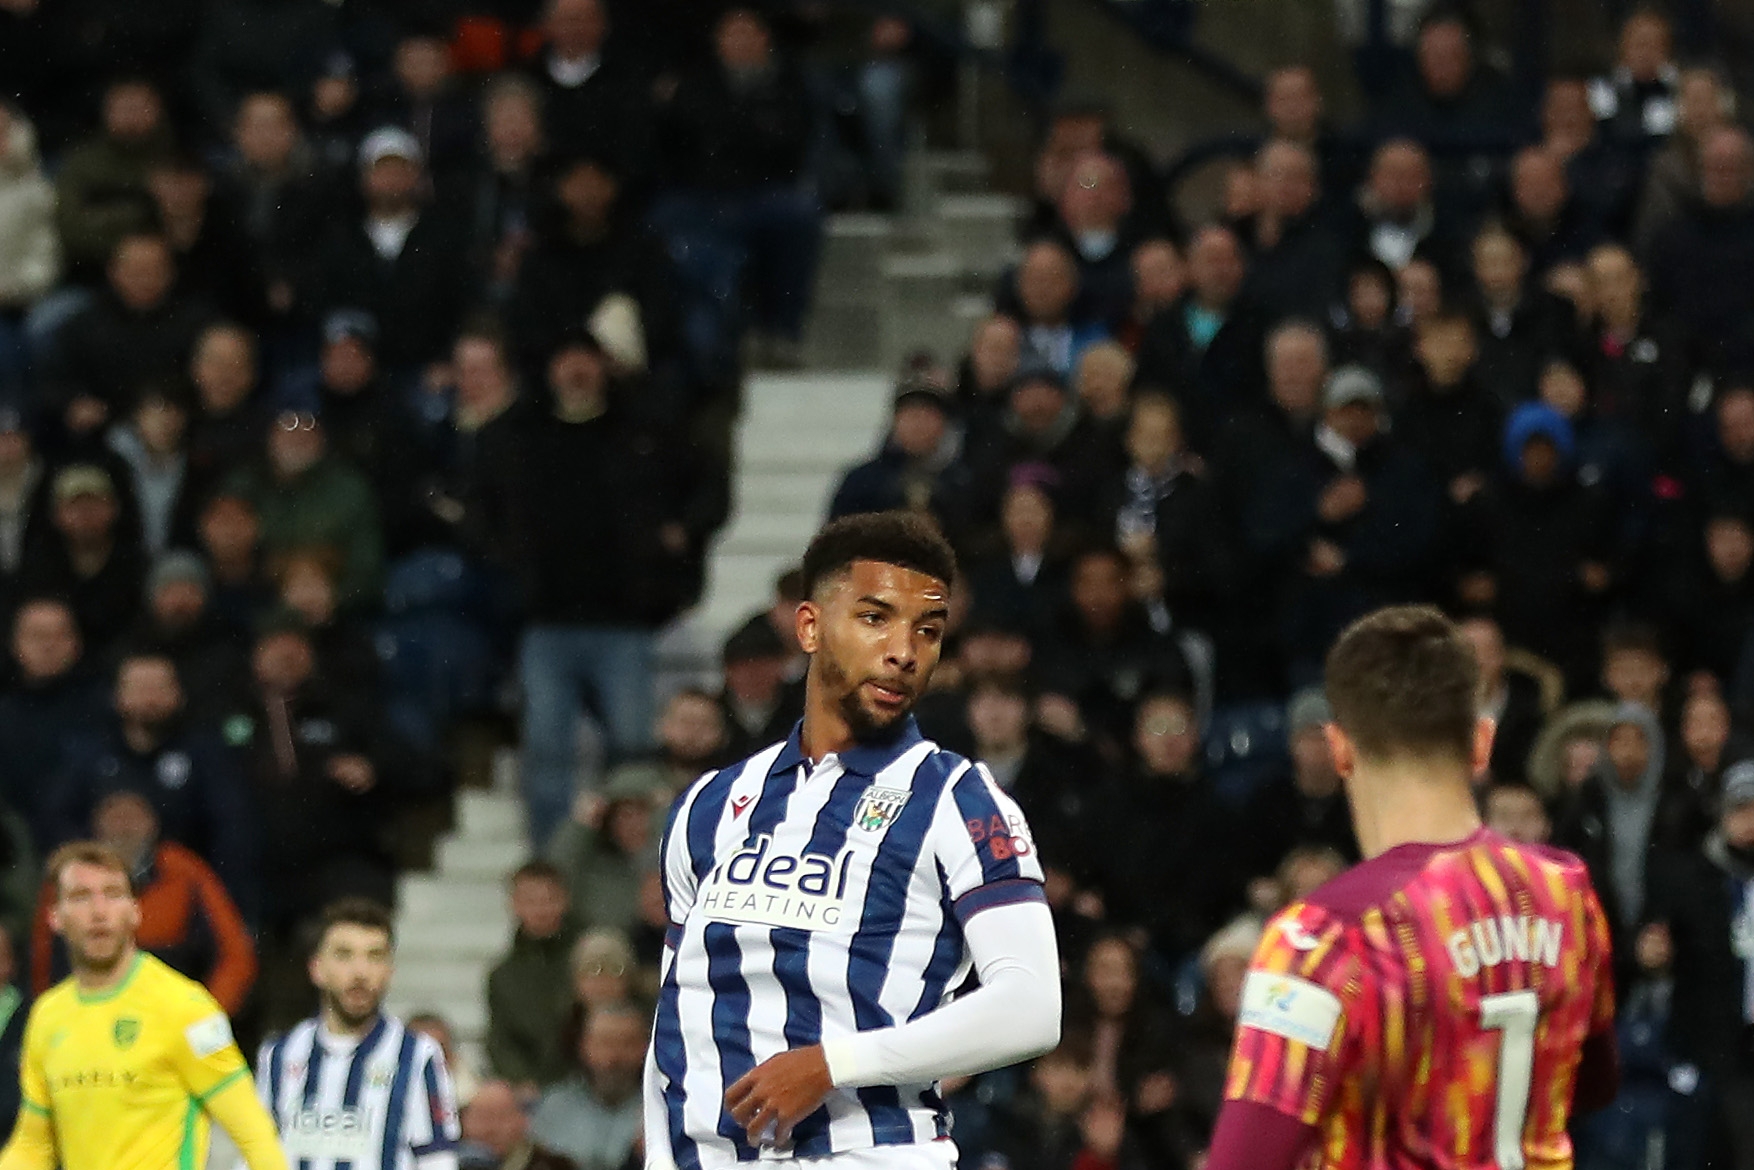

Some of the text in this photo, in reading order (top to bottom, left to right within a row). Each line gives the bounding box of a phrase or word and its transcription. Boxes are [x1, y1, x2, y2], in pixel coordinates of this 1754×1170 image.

[712, 838, 855, 900] ideal
[704, 891, 841, 925] HEATING
[1448, 915, 1563, 979] GUNN
